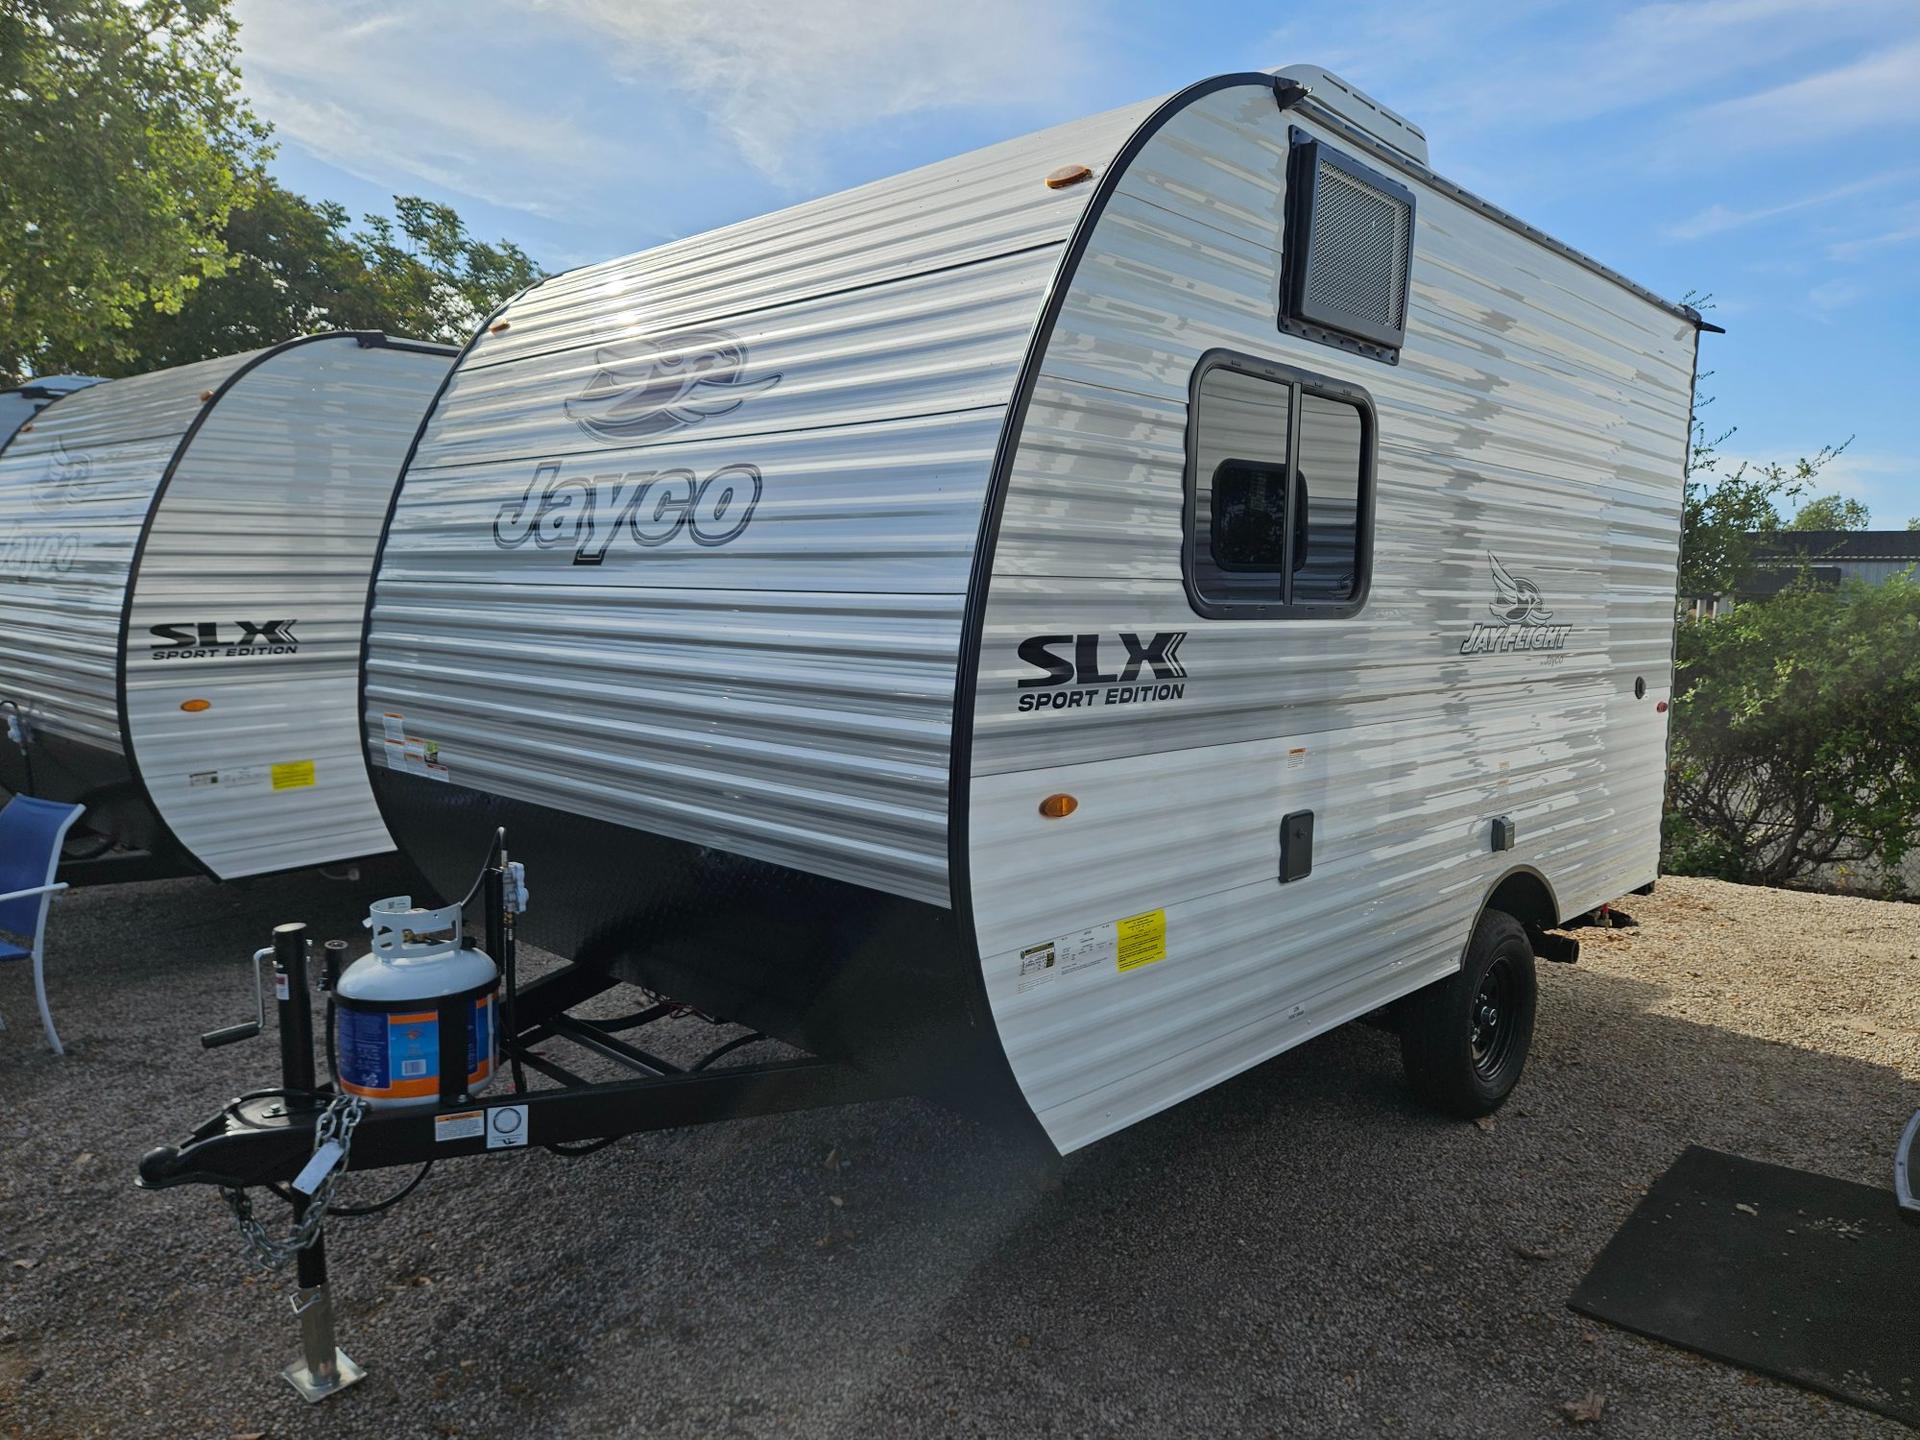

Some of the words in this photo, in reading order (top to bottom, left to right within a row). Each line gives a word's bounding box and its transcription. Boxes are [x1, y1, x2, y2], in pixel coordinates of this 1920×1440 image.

[493, 460, 763, 566] Jayco
[150, 620, 299, 649] SLX
[152, 649, 220, 660] SPORT
[226, 645, 298, 657] EDITION
[1018, 632, 1188, 688] SLX
[1018, 689, 1100, 712] SPORT
[1105, 684, 1186, 705] EDITION
